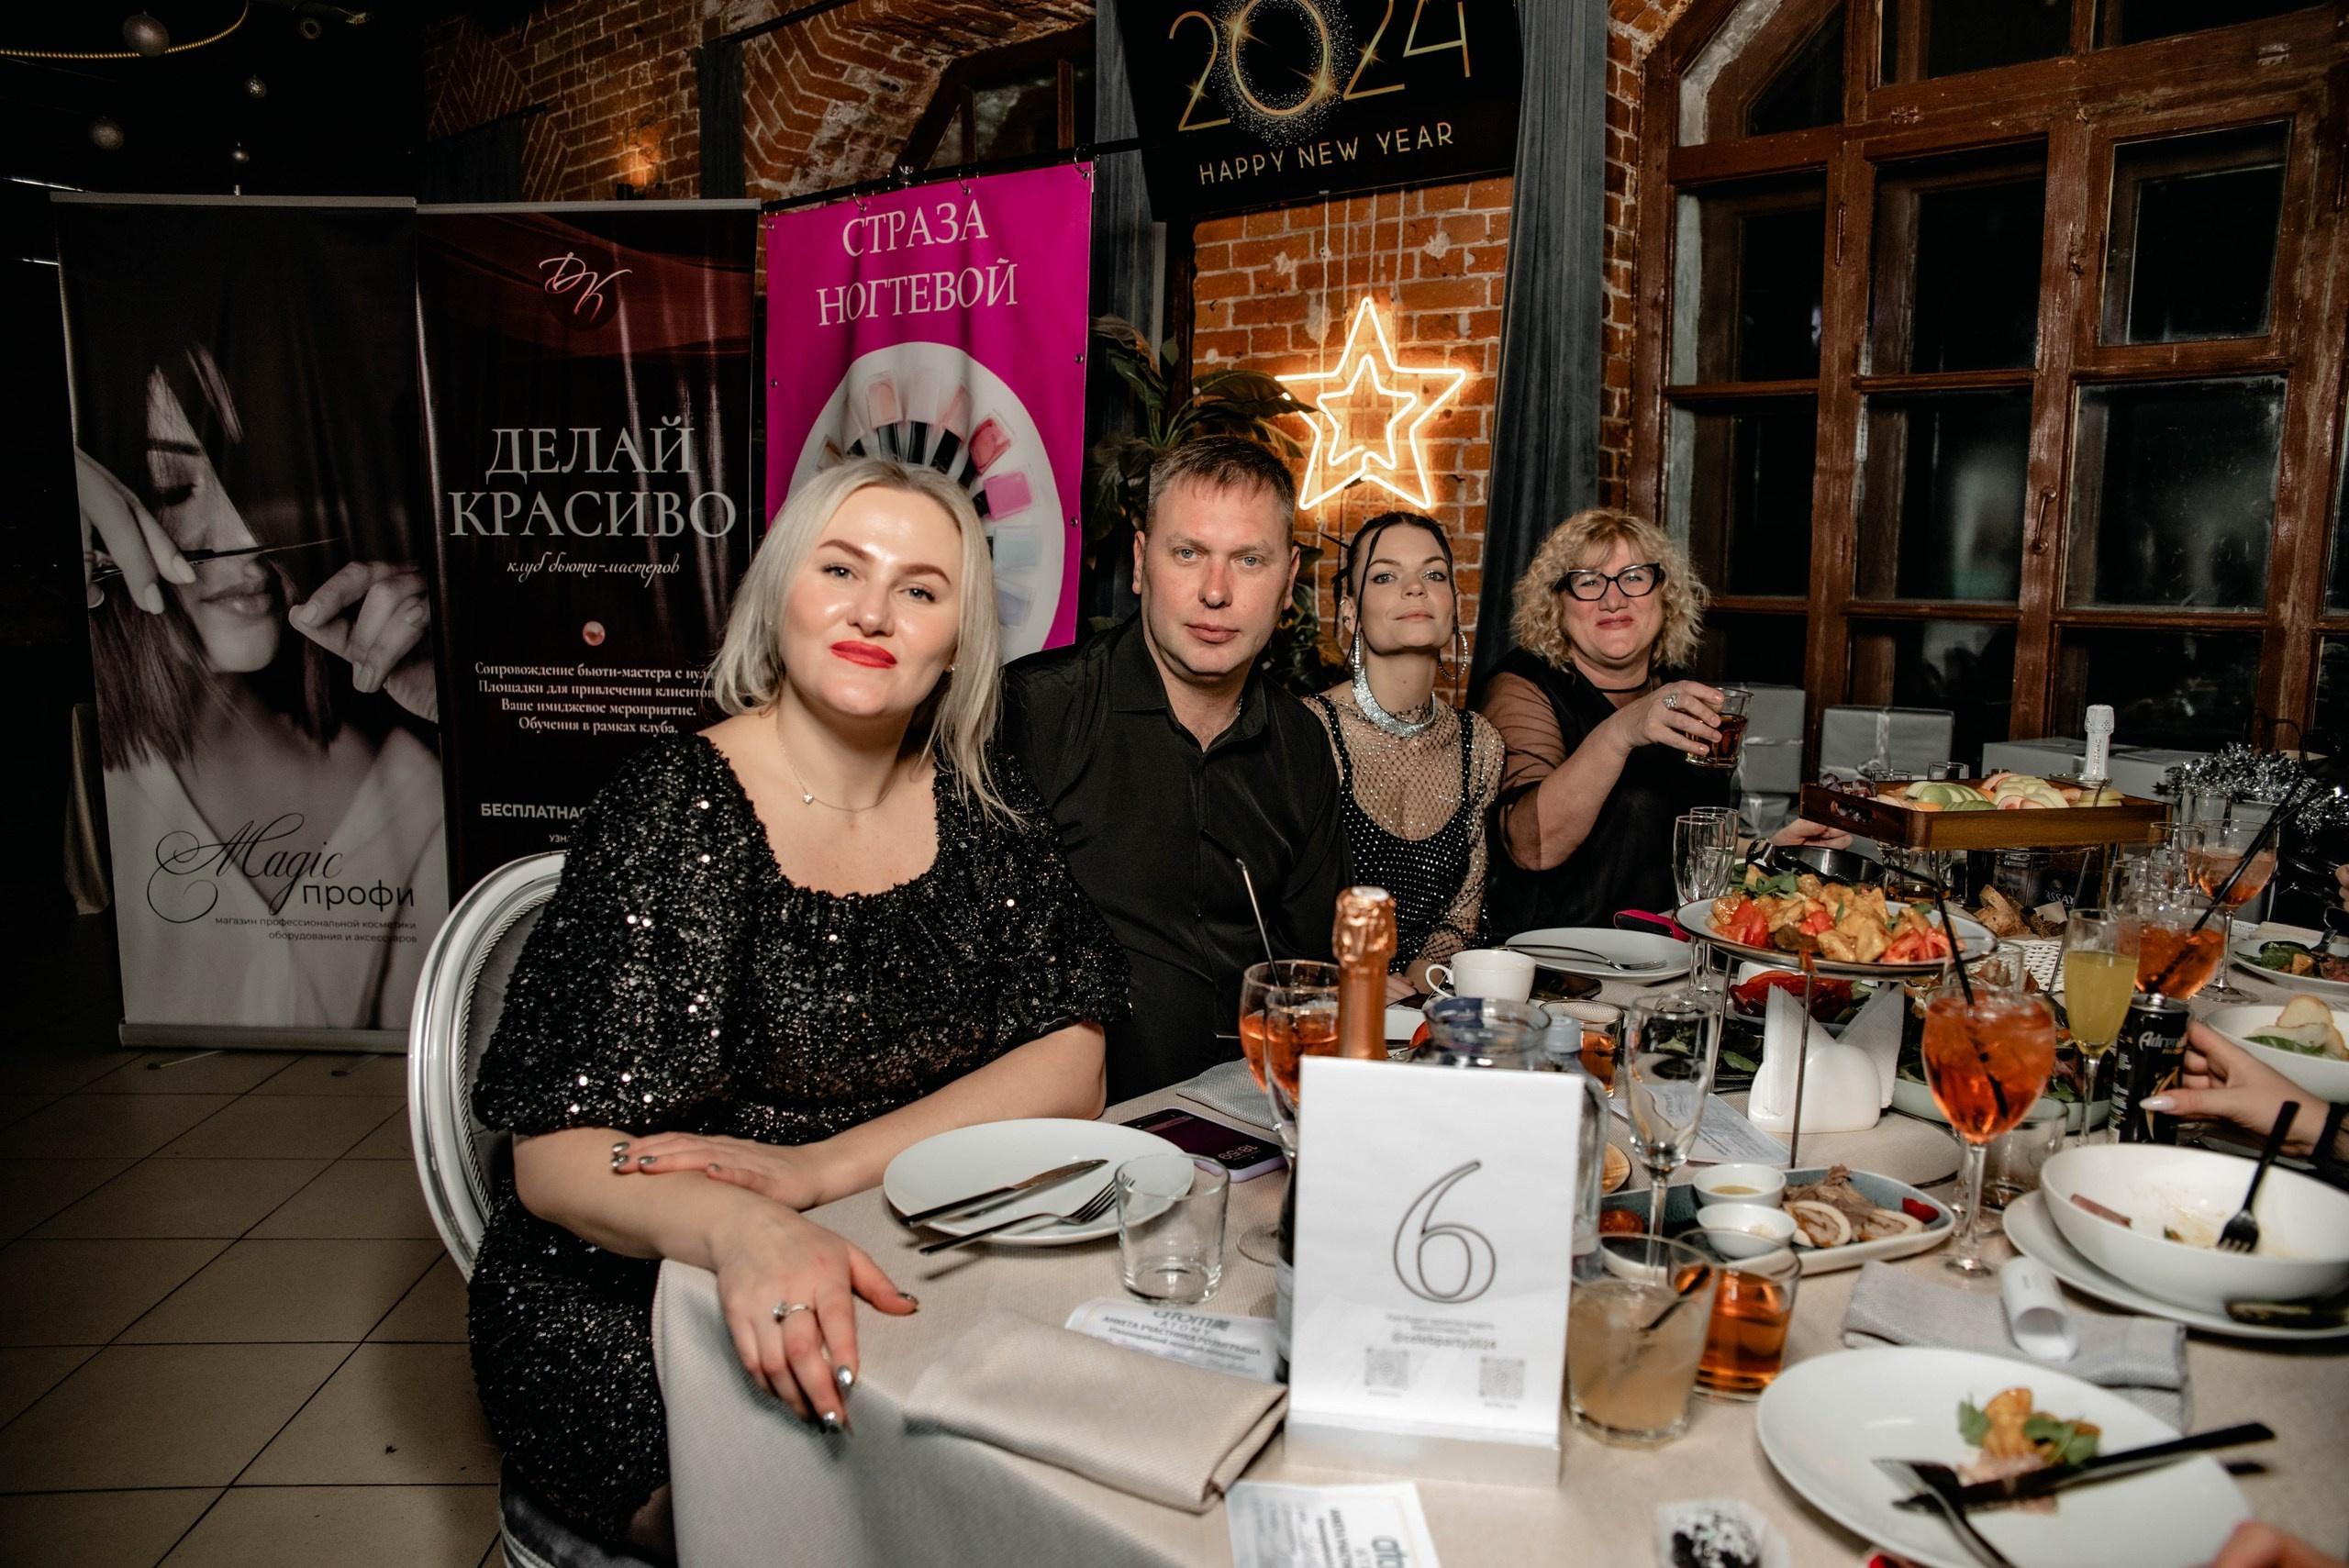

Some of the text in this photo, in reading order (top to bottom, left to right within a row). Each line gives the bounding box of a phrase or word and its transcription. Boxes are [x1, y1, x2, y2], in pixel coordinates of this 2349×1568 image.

[1169, 0, 1471, 132] 2024
[1199, 121, 1454, 184] HAPPY NEW YEAR
[842, 199, 989, 257] СТРАЗА
[816, 258, 1018, 327] НОГТЕВОЙ
[485, 416, 695, 484] ДЕЛАЙ
[448, 491, 737, 539] КРАСИВО
[507, 551, 681, 588] клуб бьюти-мастеров
[474, 662, 575, 679] Сопровождение
[577, 663, 672, 680] бьюти-мастера
[674, 670, 683, 679] с
[478, 680, 543, 695] Площадки
[546, 684, 568, 695] для
[571, 684, 652, 698] привлечения
[501, 698, 696, 718] Ваше имиджевое мероприятие.
[518, 717, 679, 737] Обучения в рамках клуба.
[147, 813, 343, 923] Magic
[303, 879, 415, 912] профи
[215, 917, 417, 930] магазин профессиональной косметики
[269, 931, 342, 941] оборудования
[354, 934, 417, 944] аксессуаров
[1218, 1144, 1259, 1161] 18:59
[1393, 1159, 1497, 1305] 6
